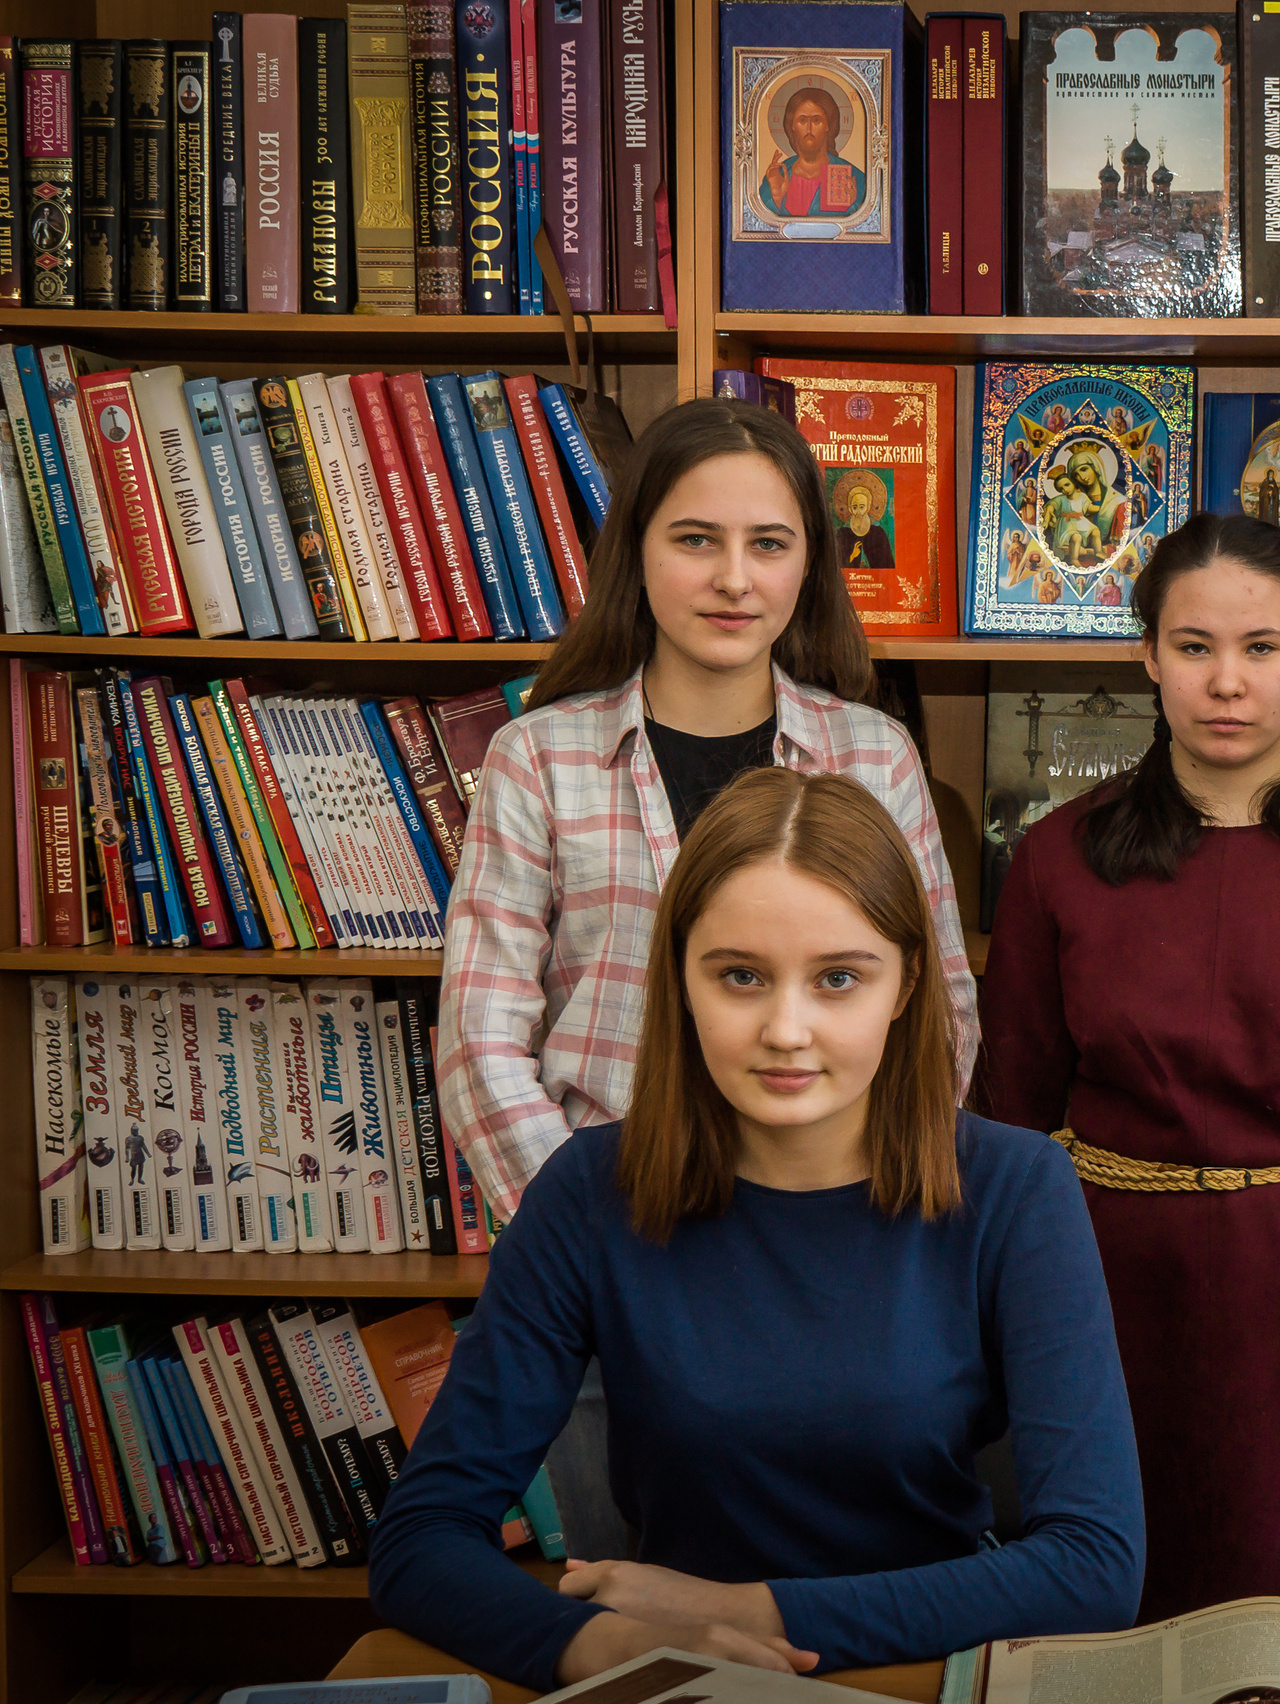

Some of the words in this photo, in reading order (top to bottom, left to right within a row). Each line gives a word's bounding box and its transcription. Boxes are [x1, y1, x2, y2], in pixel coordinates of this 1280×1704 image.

[222, 65, 232, 97] ВЕКА
[258, 52, 267, 103] ВЕЛИКАЯ
[269, 57, 279, 99] СУДЬБА
[414, 62, 425, 125] ИСТОРИЯ
[561, 40, 578, 146] КУЛЬТУРА
[623, 53, 649, 148] НАРОДНАЯ
[1056, 73, 1141, 90] ПРАВОСЛАВНЫЕ
[1146, 73, 1215, 90] МОНАСТЫРИ
[41, 74, 53, 151] ИСТОРИЯ
[222, 104, 234, 162] СРЕДНИЕ
[1264, 76, 1280, 149] МОНАСТЫРИ
[84, 136, 93, 198] СЛАВЯНСКАЯ
[96, 136, 106, 198] ЭНЦИКЛОПЕДИЯ
[178, 122, 187, 169] ИСТОРИЯ
[188, 134, 204, 216] ЕКАТЕРИНЫ
[317, 137, 333, 164] 300
[371, 131, 381, 196] ПОТОМСТВО
[383, 131, 397, 195] РЮРИКА
[430, 100, 452, 206] РОССИИ
[465, 67, 504, 285] РОССИЯ
[258, 131, 281, 230] РОССИЯ
[417, 129, 430, 245] НЕОФИЦИАЛЬНАЯ
[563, 156, 579, 254] РУССКАЯ
[631, 163, 643, 211] Коринфский
[1265, 154, 1280, 242] ПРАВОСЛАВНЫЕ
[179, 174, 187, 283] ИЛЛЮСТРИРОВАННАЯ
[313, 180, 336, 303] РОМАНОВЫ
[633, 213, 643, 247] Аполлон
[942, 231, 950, 274] ТАБЛИЦЫ
[189, 238, 204, 283] ПЕТРА
[1024, 378, 1113, 419] ПРАВОСЛАВНЫЕ
[1113, 386, 1152, 423] ИКОНЫ
[15, 417, 34, 479] ИСТОРИЯ
[38, 433, 54, 476] ИСТОРИЯ
[159, 428, 191, 484] РОССИИ
[829, 431, 889, 442] Преподобный
[840, 442, 924, 465] РАДОНЕЖСКИЙ
[113, 446, 152, 533] ИСТОРИЯ
[210, 444, 237, 507] РОССИИ
[493, 440, 518, 499] ИСТОРИИ
[29, 481, 54, 548] РУССКАЯ
[50, 483, 70, 526] РУССКАЯ
[174, 488, 206, 546] ГОРОДА
[463, 487, 487, 533] ПОБЕДЫ
[508, 500, 533, 556] РУССКОЙ
[83, 518, 109, 557] 1000
[229, 514, 256, 584] ИСТОРИЯ
[477, 536, 499, 583] РУССКИЕ
[132, 533, 167, 612] РУССКАЯ
[521, 557, 541, 597] ГЕРОИ
[105, 679, 121, 727] ТЕХНИКА
[114, 727, 127, 761] ВОКРУГ
[121, 763, 132, 789] НАС
[142, 686, 172, 766] ШКОЛЬНИКА
[175, 699, 191, 732] OXFORD
[396, 717, 421, 771] Брокгауз
[411, 719, 432, 760] Ефрон
[238, 703, 260, 746] ДЕТСКИЙ
[254, 745, 269, 773] АТЛАС
[264, 774, 278, 799] МИРА
[127, 796, 143, 856] ЭНЦИКЛОПЕДИЯ
[136, 757, 149, 792] ДЕТСКАЯ
[143, 793, 162, 856] ЭНЦИКЛОПЕДИЯ
[155, 857, 169, 892] ТЕХНИКИ
[162, 767, 199, 864] ЭНЦИКЛОПЕДИЯ
[184, 735, 210, 785] БОЛЬШАЯ
[198, 785, 223, 829] ДЕТСКАЯ
[212, 829, 248, 912] ЭНЦИКЛОПЕДИЯ
[393, 776, 420, 832] ИСКУССТВО
[53, 805, 73, 894] ШЕДЕВРЫ
[188, 866, 210, 908] НОВАЯ
[119, 1004, 138, 1043] мир
[180, 1003, 200, 1061] РОССИИ
[216, 1007, 238, 1047] мир
[407, 999, 422, 1055] БОЛЬШАЯ
[45, 1020, 65, 1156] Насекомые
[86, 1011, 110, 1114] Земля
[119, 1043, 146, 1122] Древний
[151, 1012, 175, 1112] Космос
[251, 1021, 280, 1157] Растения
[284, 1043, 298, 1114] Вымершие
[291, 1017, 315, 1142] животные
[319, 1012, 344, 1104] Птицы
[384, 1034, 406, 1106] ЭНЦИКЛОПЕДИЯ
[413, 1056, 426, 1094] КНИГА
[189, 1062, 207, 1123] История
[219, 1053, 245, 1156] Подводный
[354, 1021, 385, 1159] Животные
[416, 1095, 441, 1179] РЕКОРДОВ
[407, 1180, 420, 1224] БОЛЬШАЯ
[25, 1302, 40, 1343] ДАЙДЖЕСТ
[34, 1345, 45, 1375] РИДЕРЗ
[258, 1332, 305, 1437] ШКОЛЬНИКА
[294, 1332, 335, 1422] ВОПРОСОВ
[303, 1329, 338, 1403] ОТВЕТОВ
[394, 1342, 443, 1368] СПРАВОЧНИК
[41, 1380, 60, 1430] ЗНАНИЙ
[233, 1358, 263, 1418] ШКОЛЬНИКА
[53, 1433, 80, 1522] КАЛЕЙДОСКОП
[110, 1389, 153, 1513] ДЖЕНТЛЬМЕНОВ
[255, 1419, 285, 1481] СПРАВОЧНИК
[278, 1483, 307, 1547] НАСТОЛЬНЫЙ
